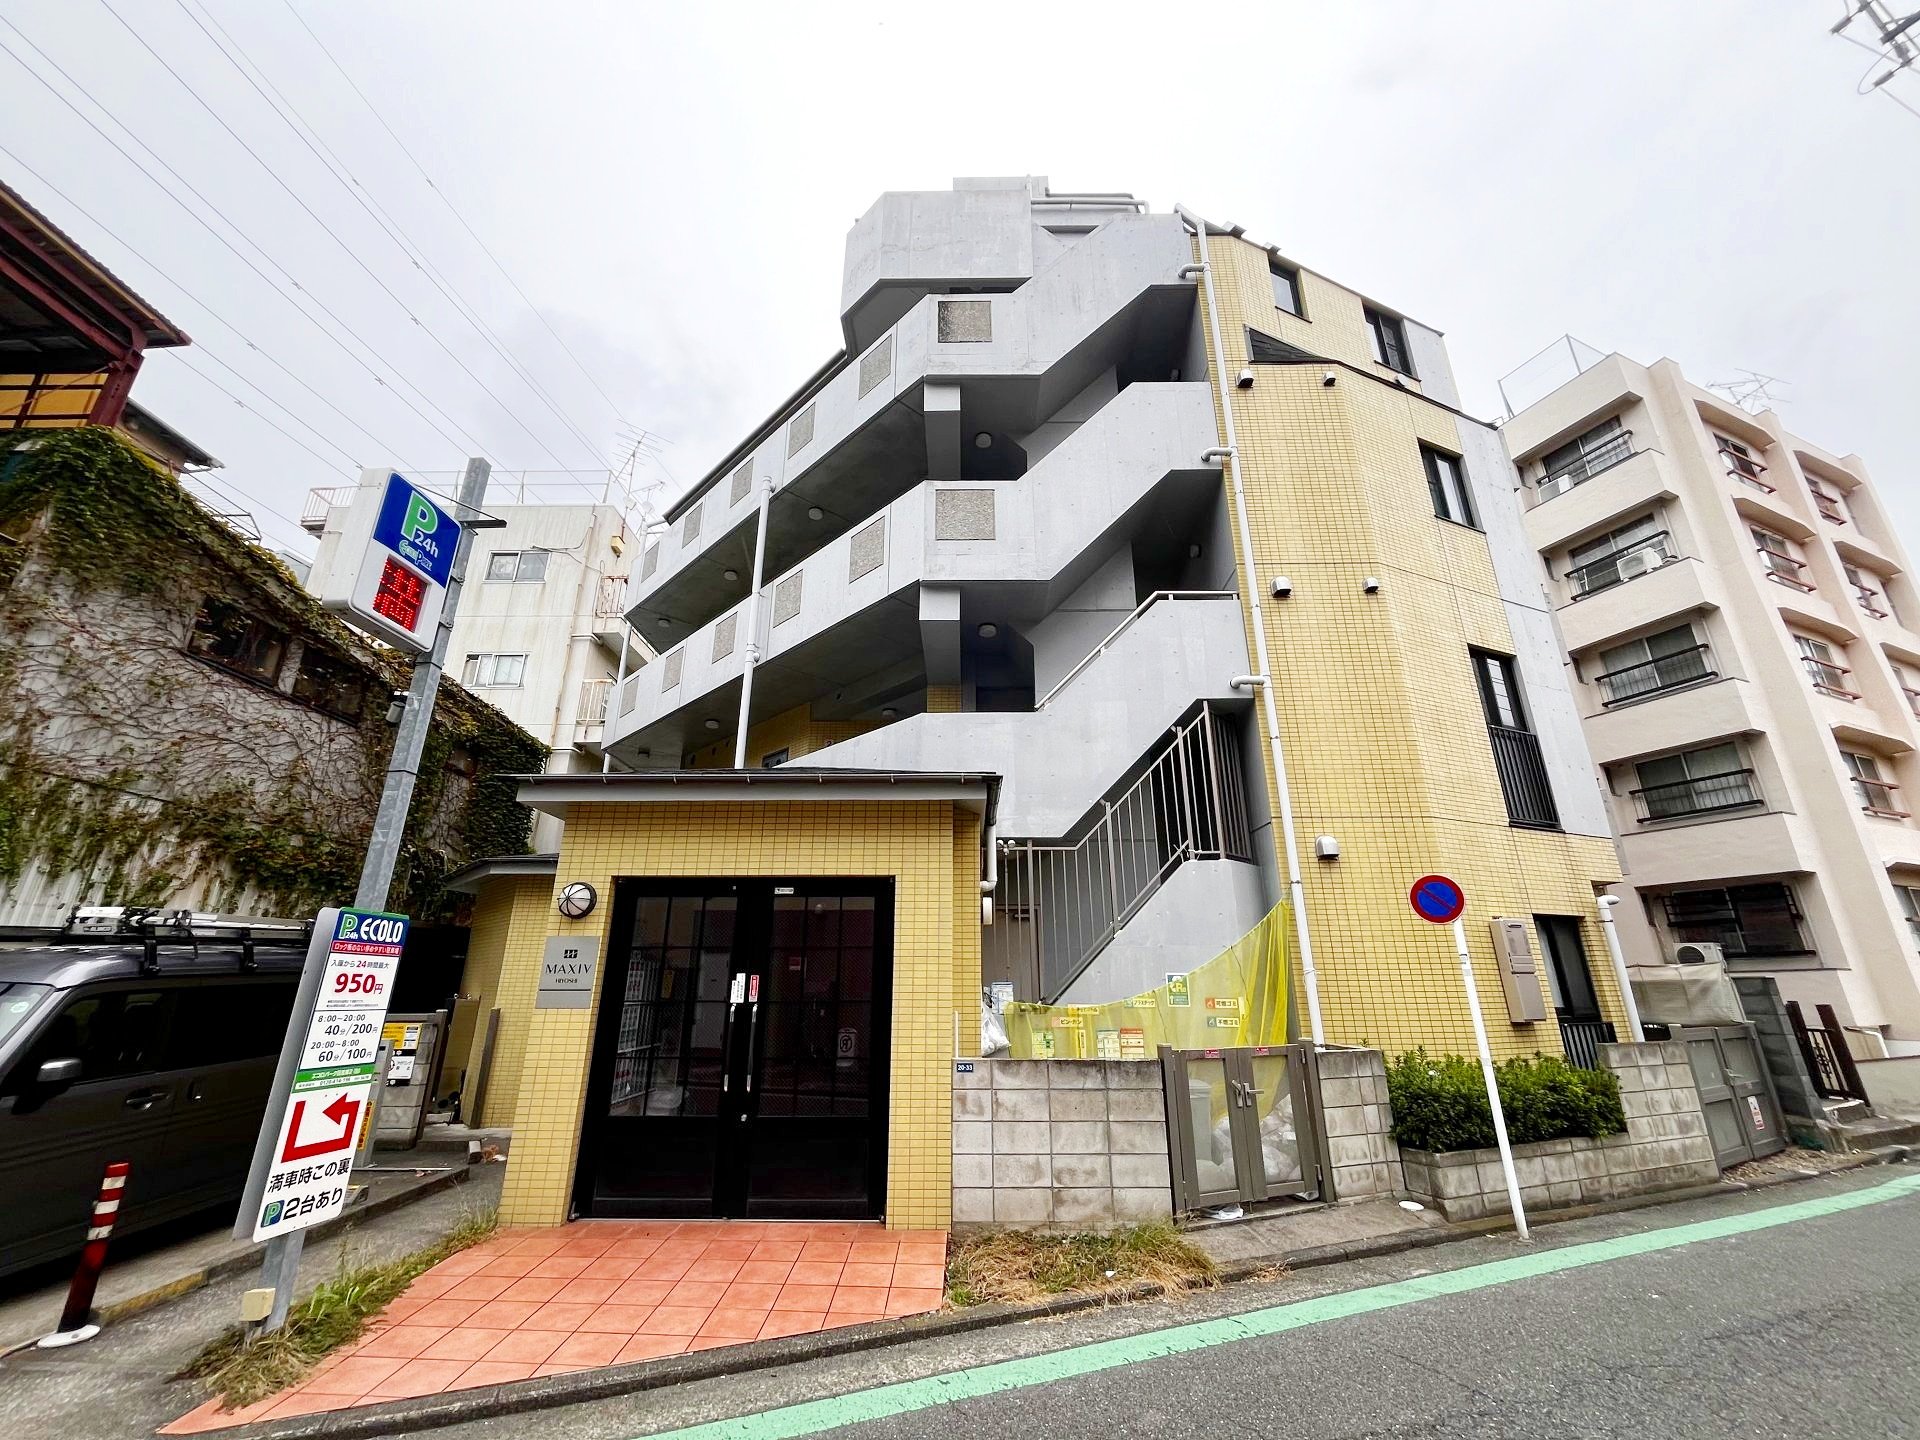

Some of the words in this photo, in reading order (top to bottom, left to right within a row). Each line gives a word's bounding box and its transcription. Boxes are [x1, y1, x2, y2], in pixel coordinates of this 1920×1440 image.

[401, 489, 438, 542] P
[414, 530, 439, 558] 24h
[345, 931, 358, 940] 24h
[360, 918, 404, 943] ECOLO
[334, 973, 384, 994] 950円
[267, 1157, 352, 1193] 満車時この裏
[283, 1187, 343, 1221] 2台あり
